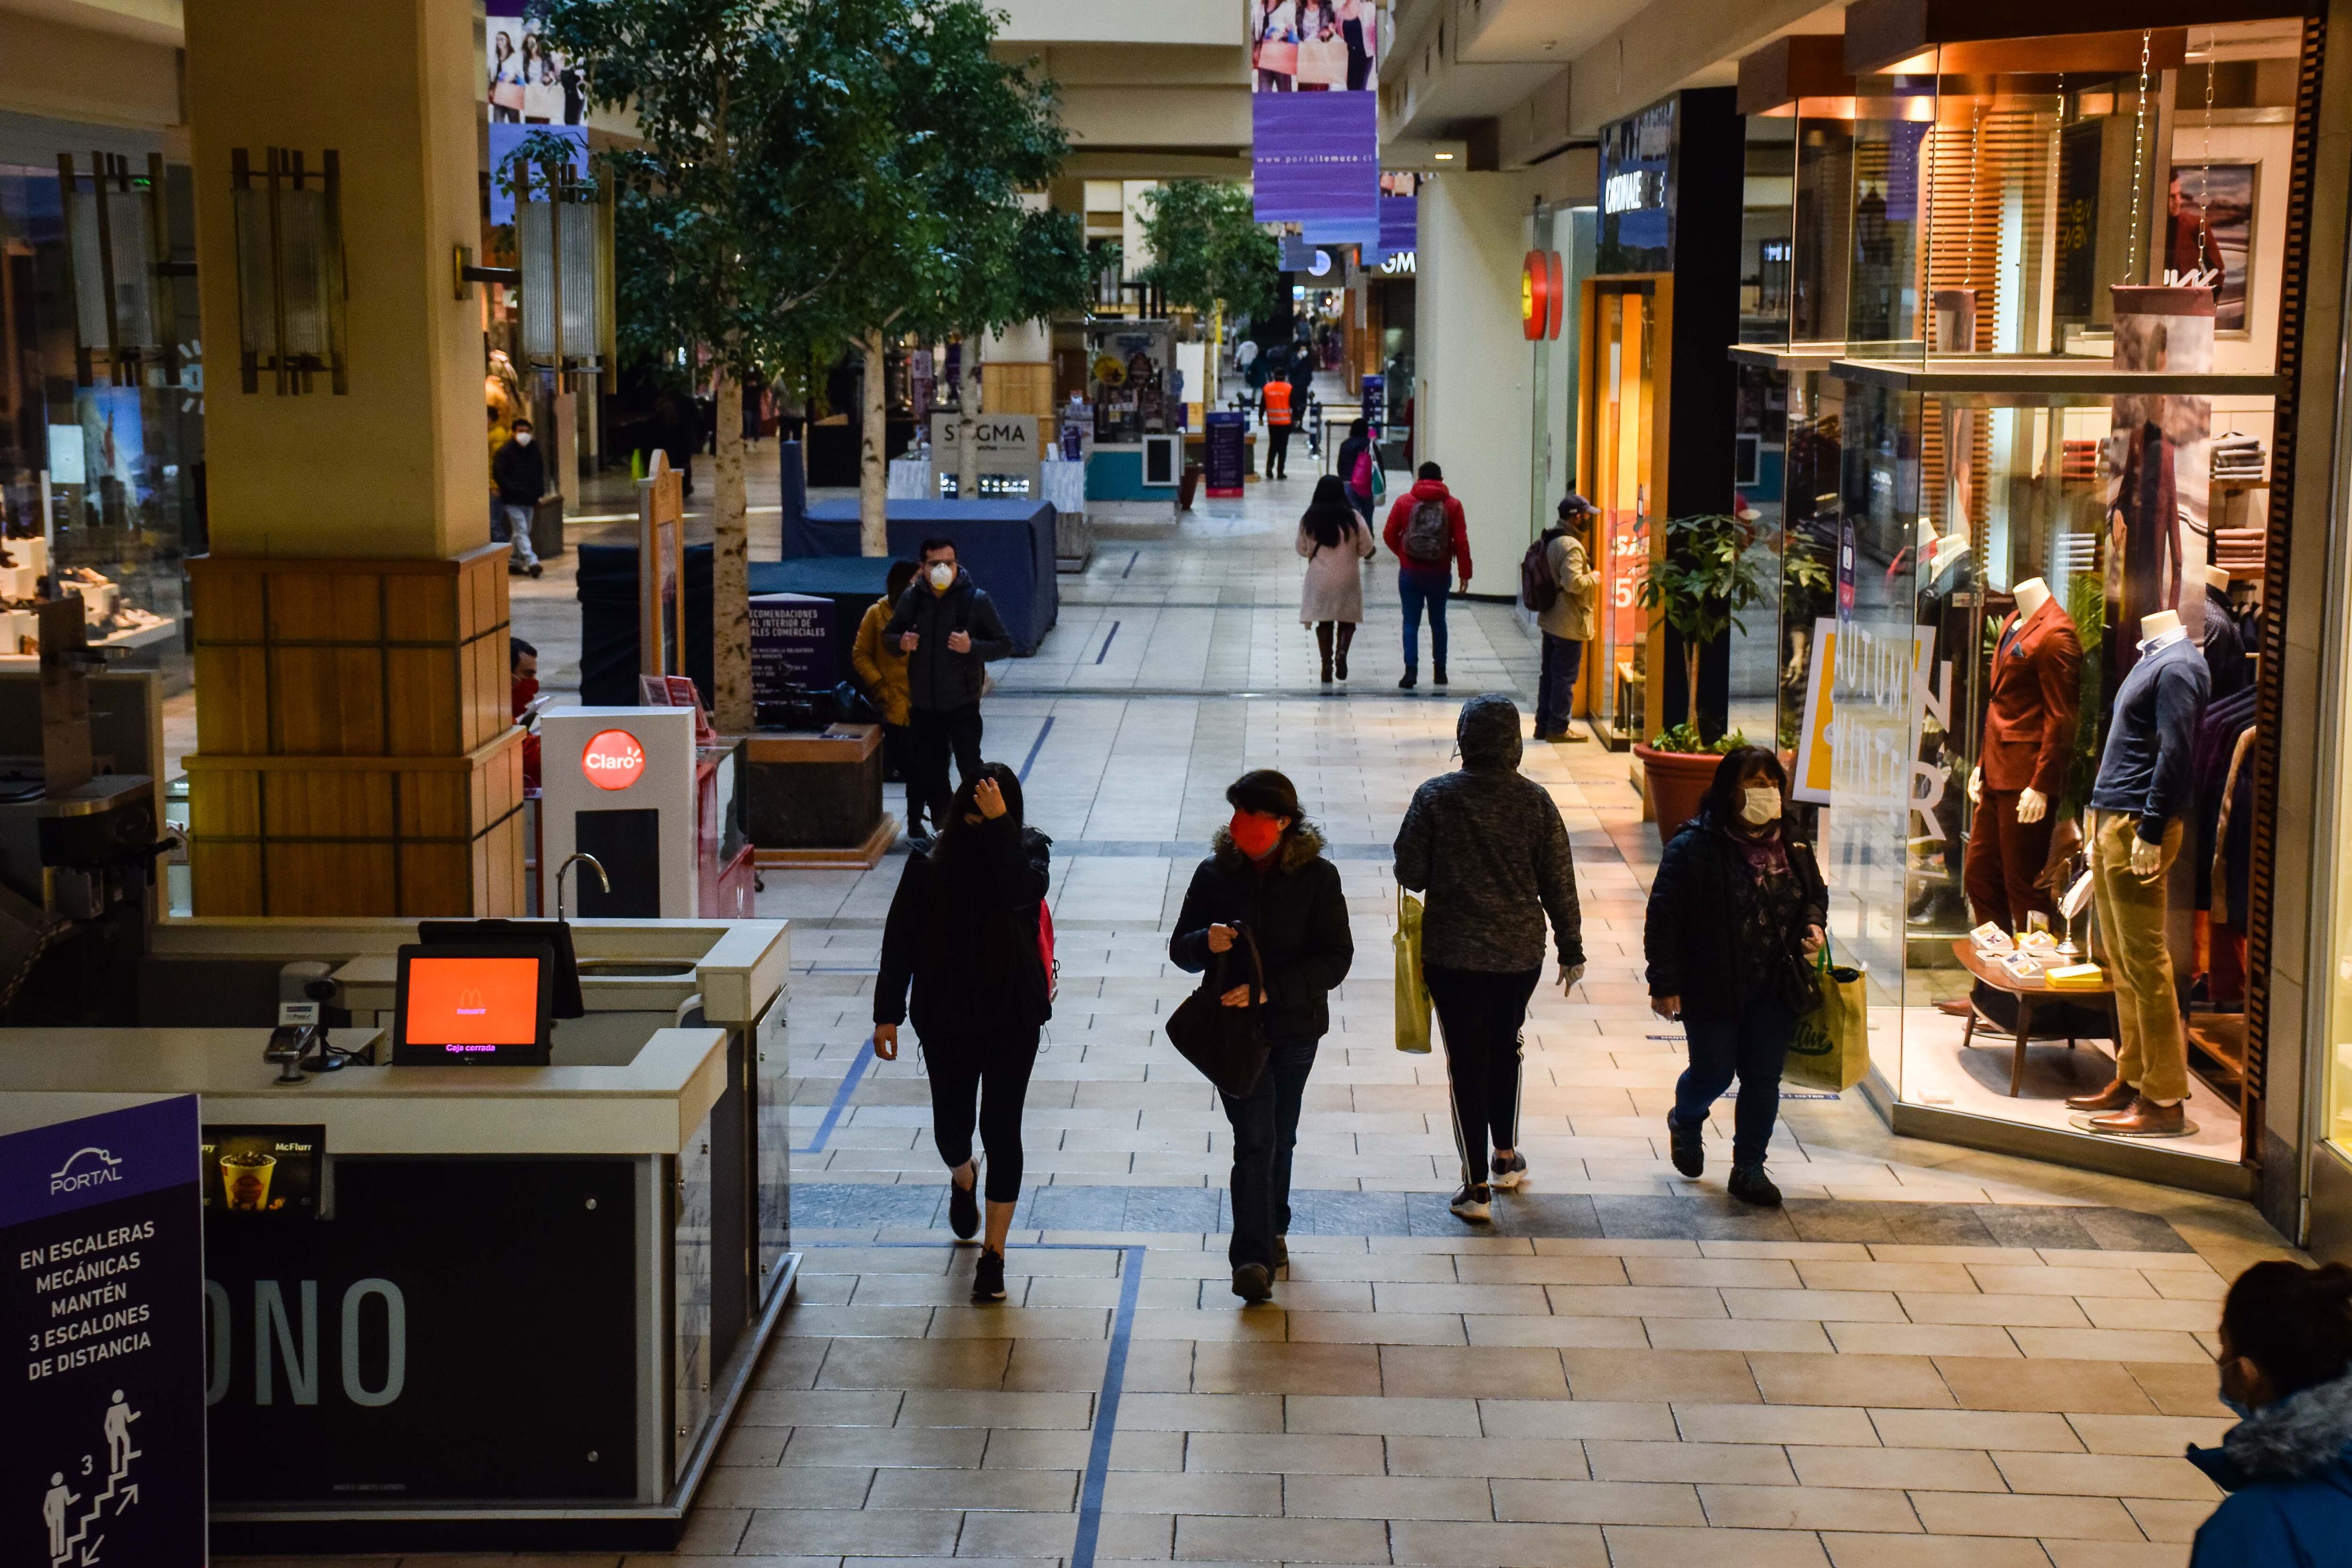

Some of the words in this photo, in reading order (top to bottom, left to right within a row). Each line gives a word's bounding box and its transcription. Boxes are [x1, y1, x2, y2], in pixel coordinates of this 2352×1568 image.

[945, 424, 1025, 441] SGMA
[772, 628, 825, 636] COMERCIALES
[587, 753, 634, 769] Claro
[446, 1044, 464, 1053] Caja
[51, 1167, 122, 1195] PORTAL
[20, 1248, 44, 1269] EN
[49, 1221, 155, 1262] ESCALERAS
[36, 1252, 141, 1294] MECÁNICAS
[51, 1281, 127, 1318] MANTÉN
[29, 1335, 39, 1352] 3
[45, 1304, 150, 1348] ESCALONES
[29, 1359, 53, 1381] DE
[57, 1332, 151, 1372] DISTANCIA
[81, 1454, 93, 1476] 3
